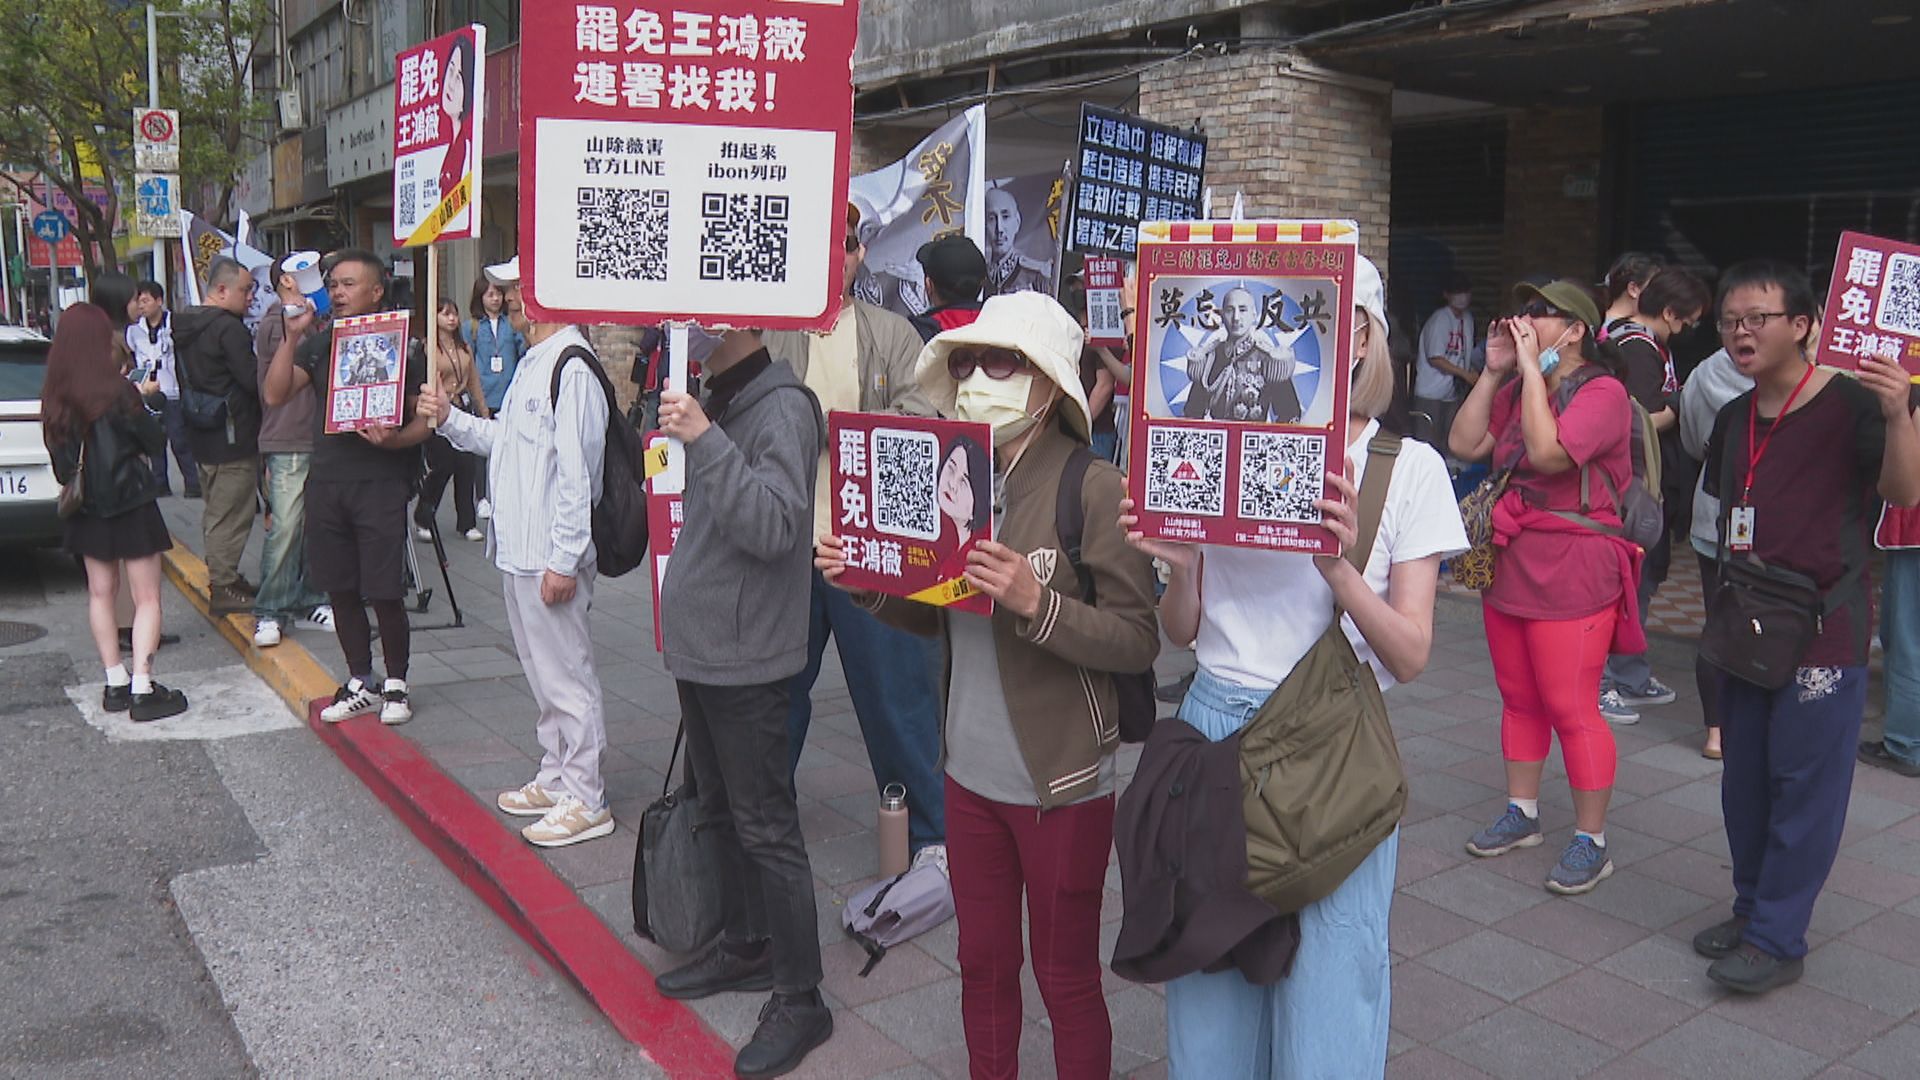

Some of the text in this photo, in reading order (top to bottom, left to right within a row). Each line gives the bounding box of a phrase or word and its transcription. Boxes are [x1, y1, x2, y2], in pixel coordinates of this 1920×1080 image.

[575, 5, 807, 63] 罷免王鴻薇
[400, 48, 439, 107] 罷免
[573, 61, 777, 113] 連署找我!
[398, 103, 440, 148] 王鴻薇
[586, 136, 664, 156] 山除薇害
[583, 158, 666, 177] 官方LINE
[720, 141, 777, 160] 拍起來
[708, 163, 787, 182] ibon列印
[1078, 182, 1141, 220] 認知作戰
[1076, 216, 1137, 253] 當務之急
[1837, 246, 1884, 326] 罷免
[1829, 327, 1904, 363] 王鴻薇
[838, 428, 868, 529] 罷免
[842, 534, 903, 578] 王鴻薇
